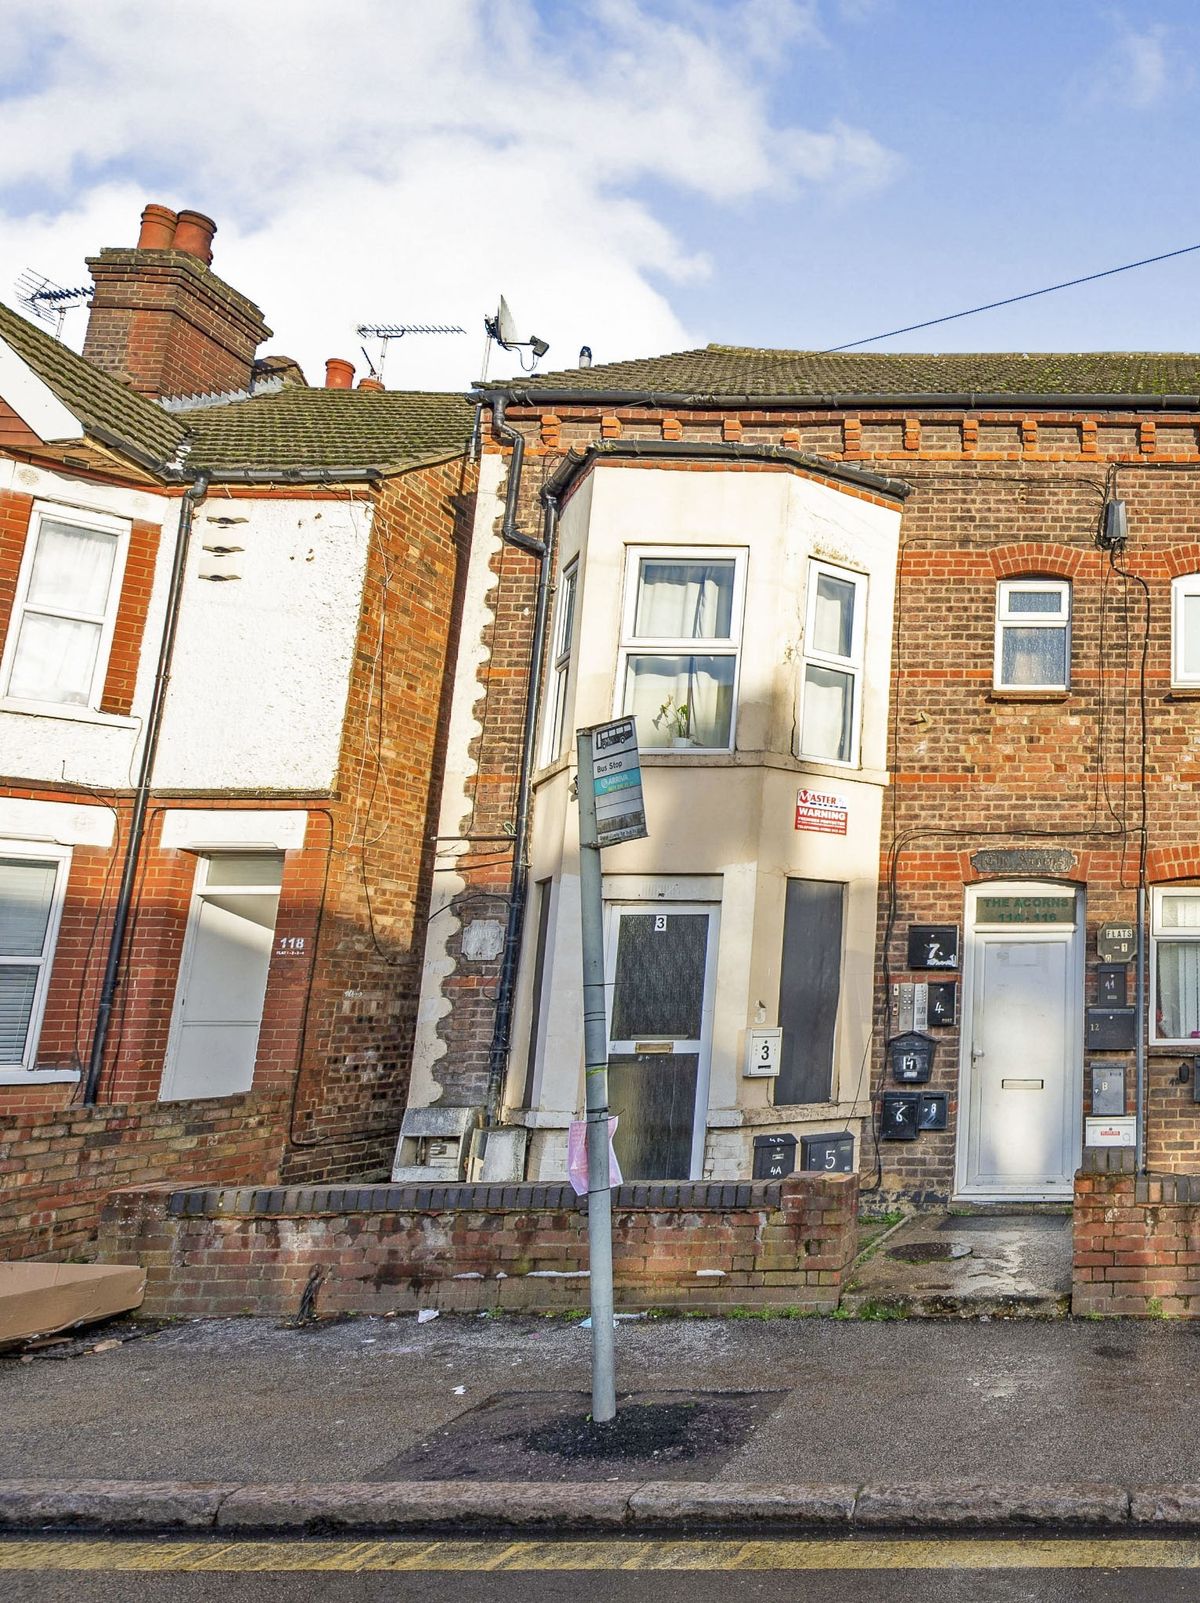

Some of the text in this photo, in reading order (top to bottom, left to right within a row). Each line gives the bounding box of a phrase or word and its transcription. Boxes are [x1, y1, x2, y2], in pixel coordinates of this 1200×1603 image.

[597, 760, 623, 773] Bus Stop
[799, 789, 836, 804] MASTER
[799, 807, 846, 821] WARNING
[983, 899, 1068, 907] THE ACORNS
[657, 917, 665, 929] 3
[280, 937, 304, 949] 118
[928, 943, 940, 959] 7
[935, 1002, 944, 1013] 4
[761, 1045, 770, 1060] 3
[930, 1103, 937, 1114] 8
[825, 1149, 836, 1169] 5
[770, 1166, 782, 1175] 4A
